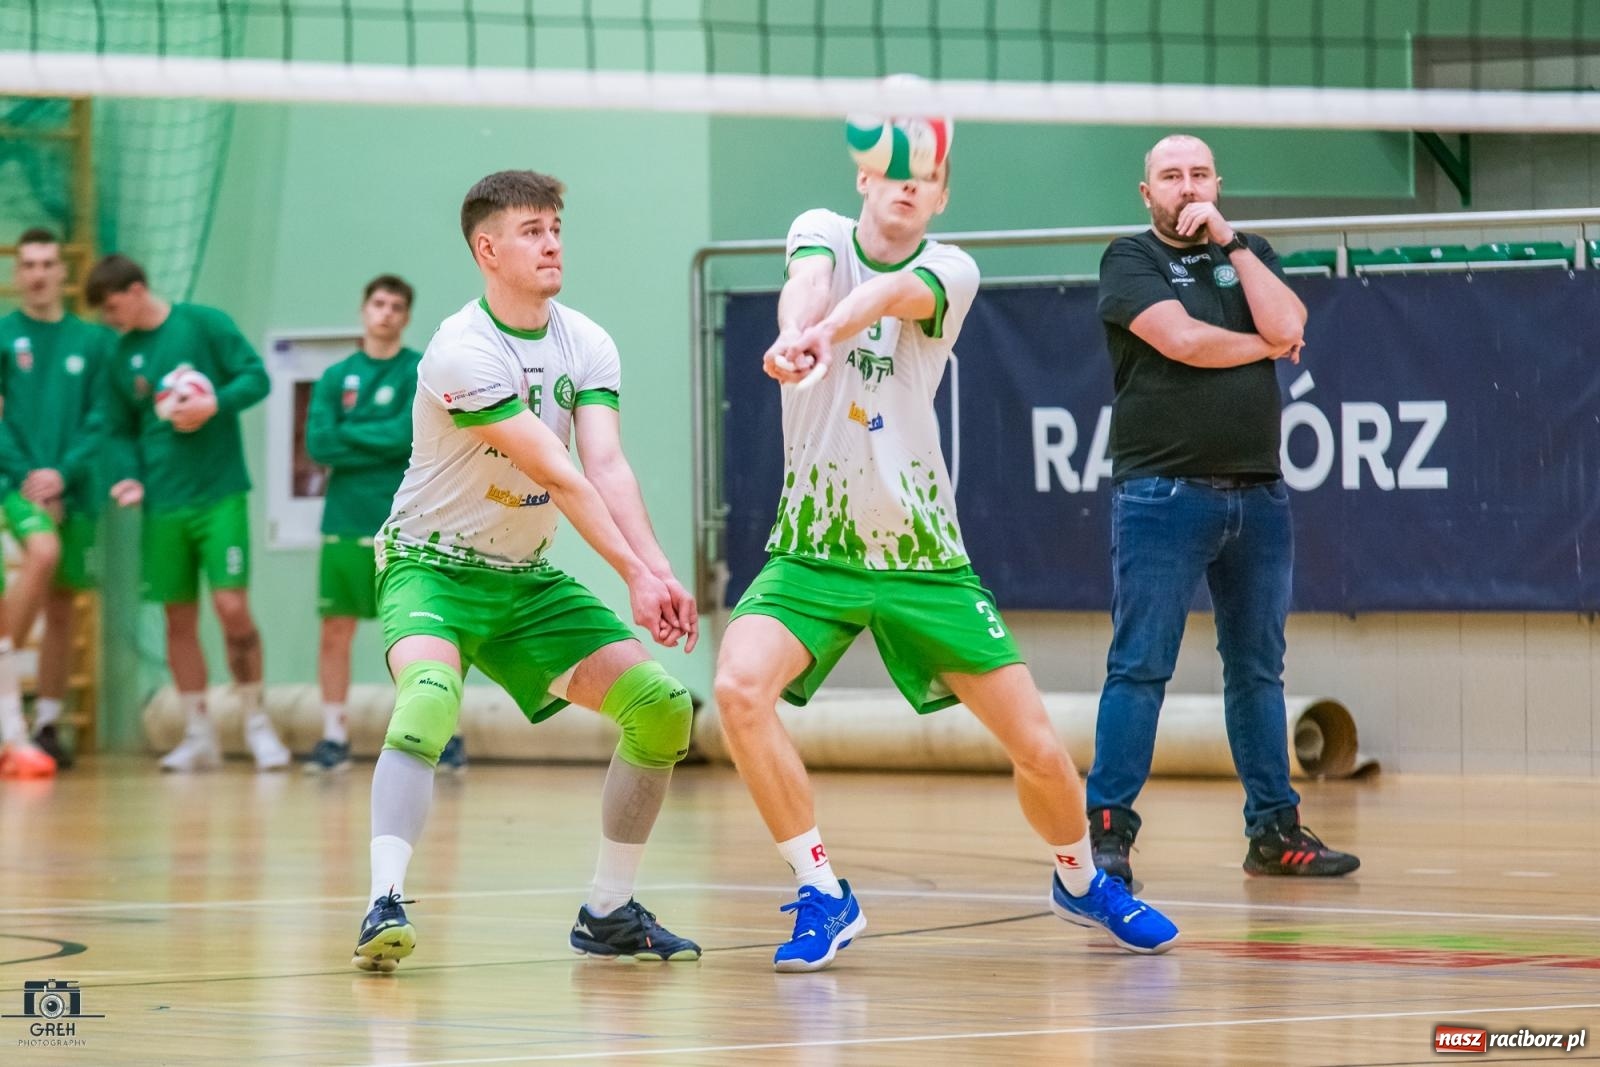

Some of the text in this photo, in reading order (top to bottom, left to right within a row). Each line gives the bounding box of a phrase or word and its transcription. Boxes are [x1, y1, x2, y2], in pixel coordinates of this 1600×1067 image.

[1032, 370, 1448, 493] RAÓRZ
[975, 600, 1006, 638] 3
[811, 843, 826, 862] R
[1056, 853, 1079, 866] R
